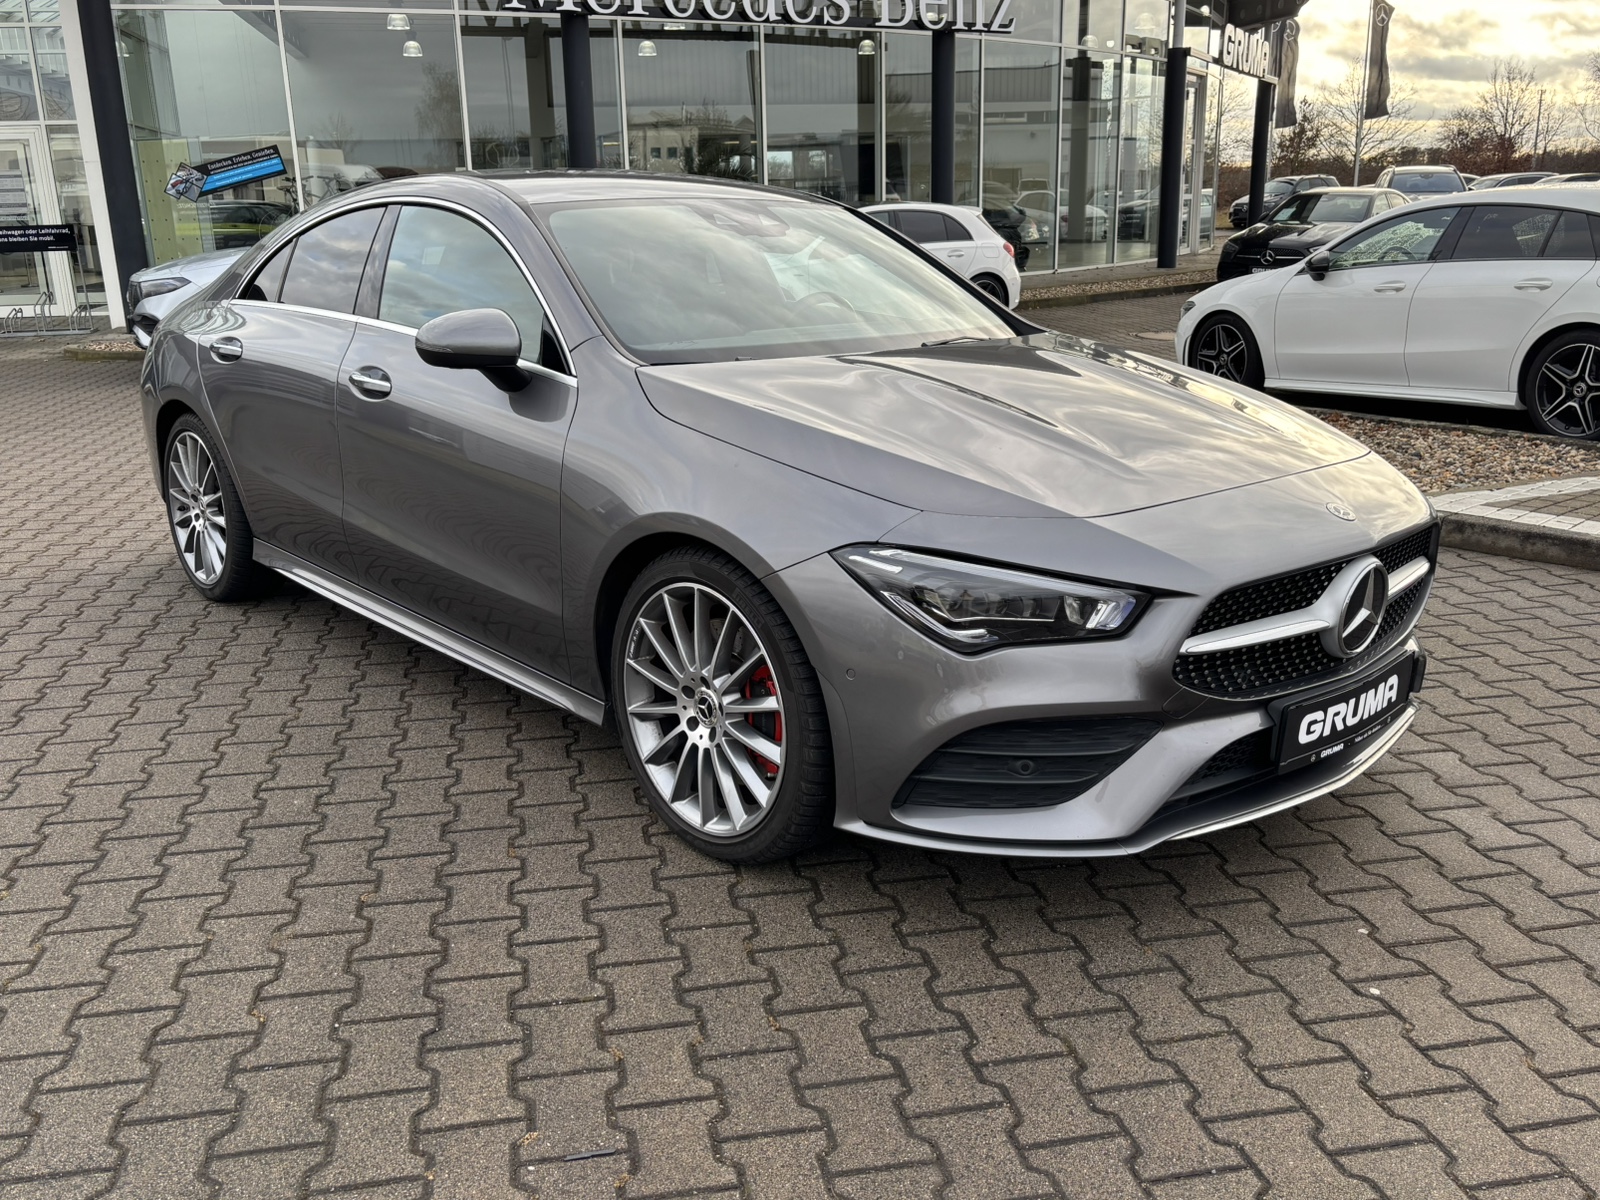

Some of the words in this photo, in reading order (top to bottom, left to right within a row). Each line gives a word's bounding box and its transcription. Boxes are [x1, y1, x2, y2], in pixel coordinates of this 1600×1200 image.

[1222, 23, 1270, 78] GRUMA
[232, 154, 251, 164] Erleben.
[1298, 674, 1398, 744] GRUMA
